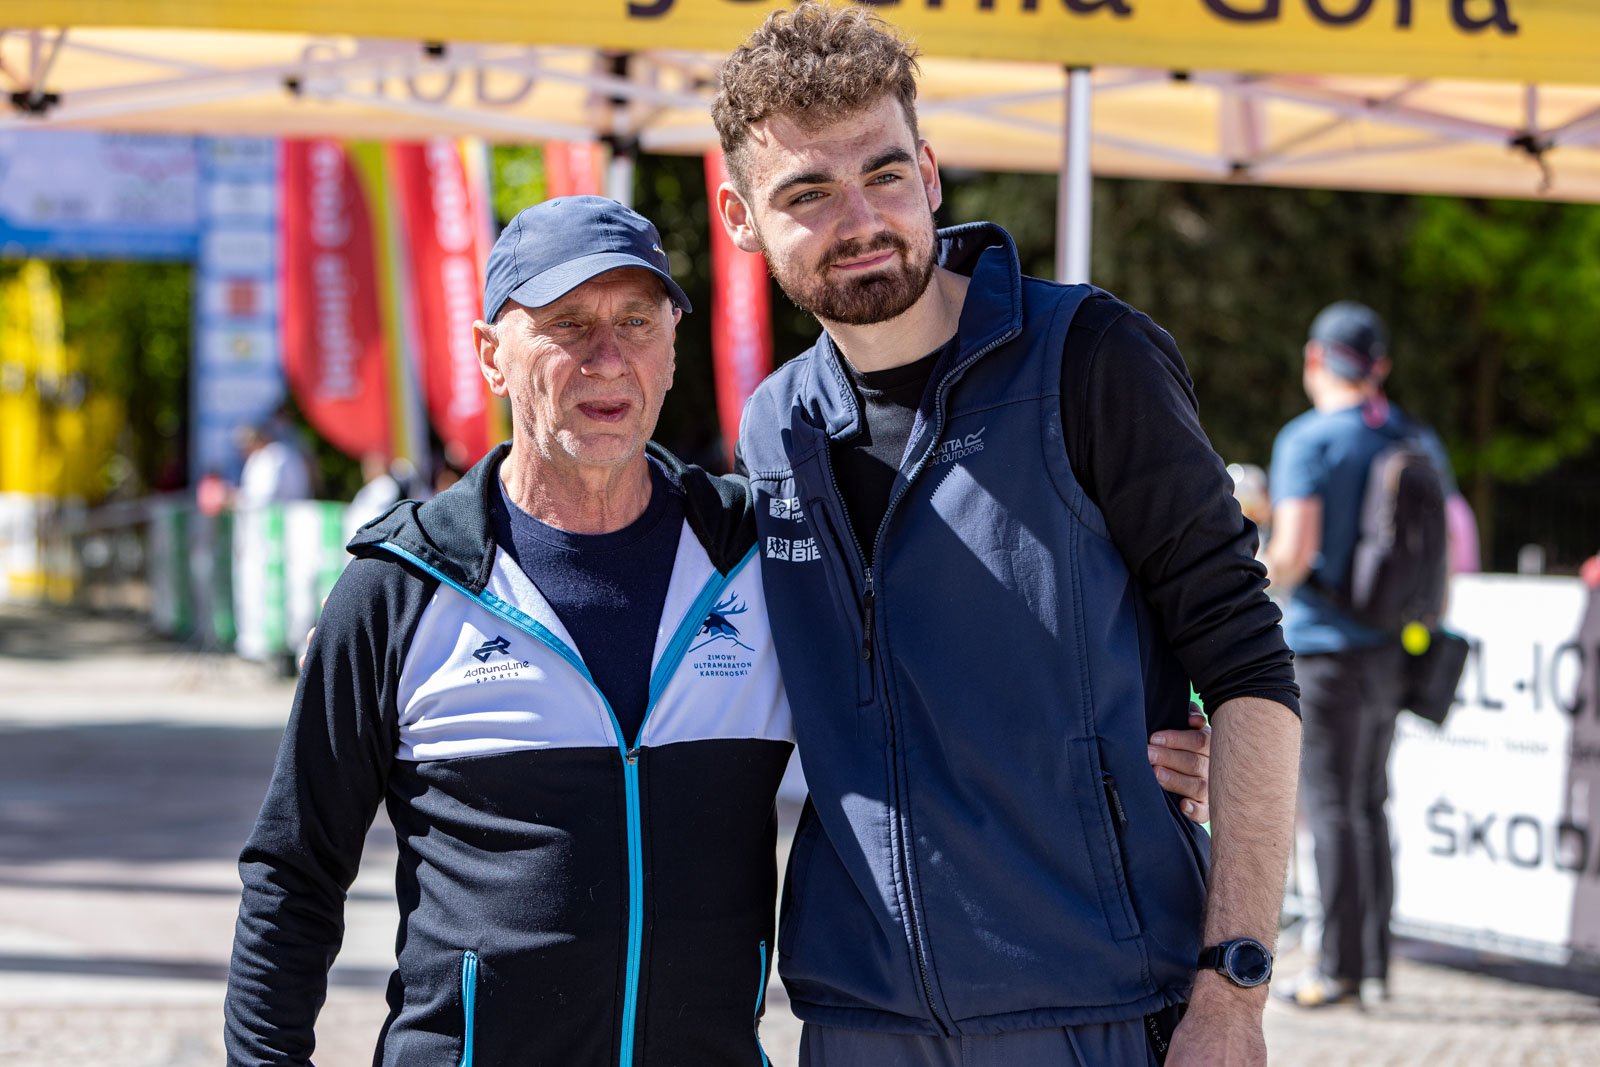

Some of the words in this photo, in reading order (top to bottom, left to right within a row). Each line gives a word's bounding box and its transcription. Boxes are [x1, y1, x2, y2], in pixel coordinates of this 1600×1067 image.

[941, 442, 985, 463] OUTDOORS
[463, 660, 529, 679] AdRunaLine
[476, 672, 519, 684] SPORTS
[1424, 796, 1600, 879] ŠKOD
